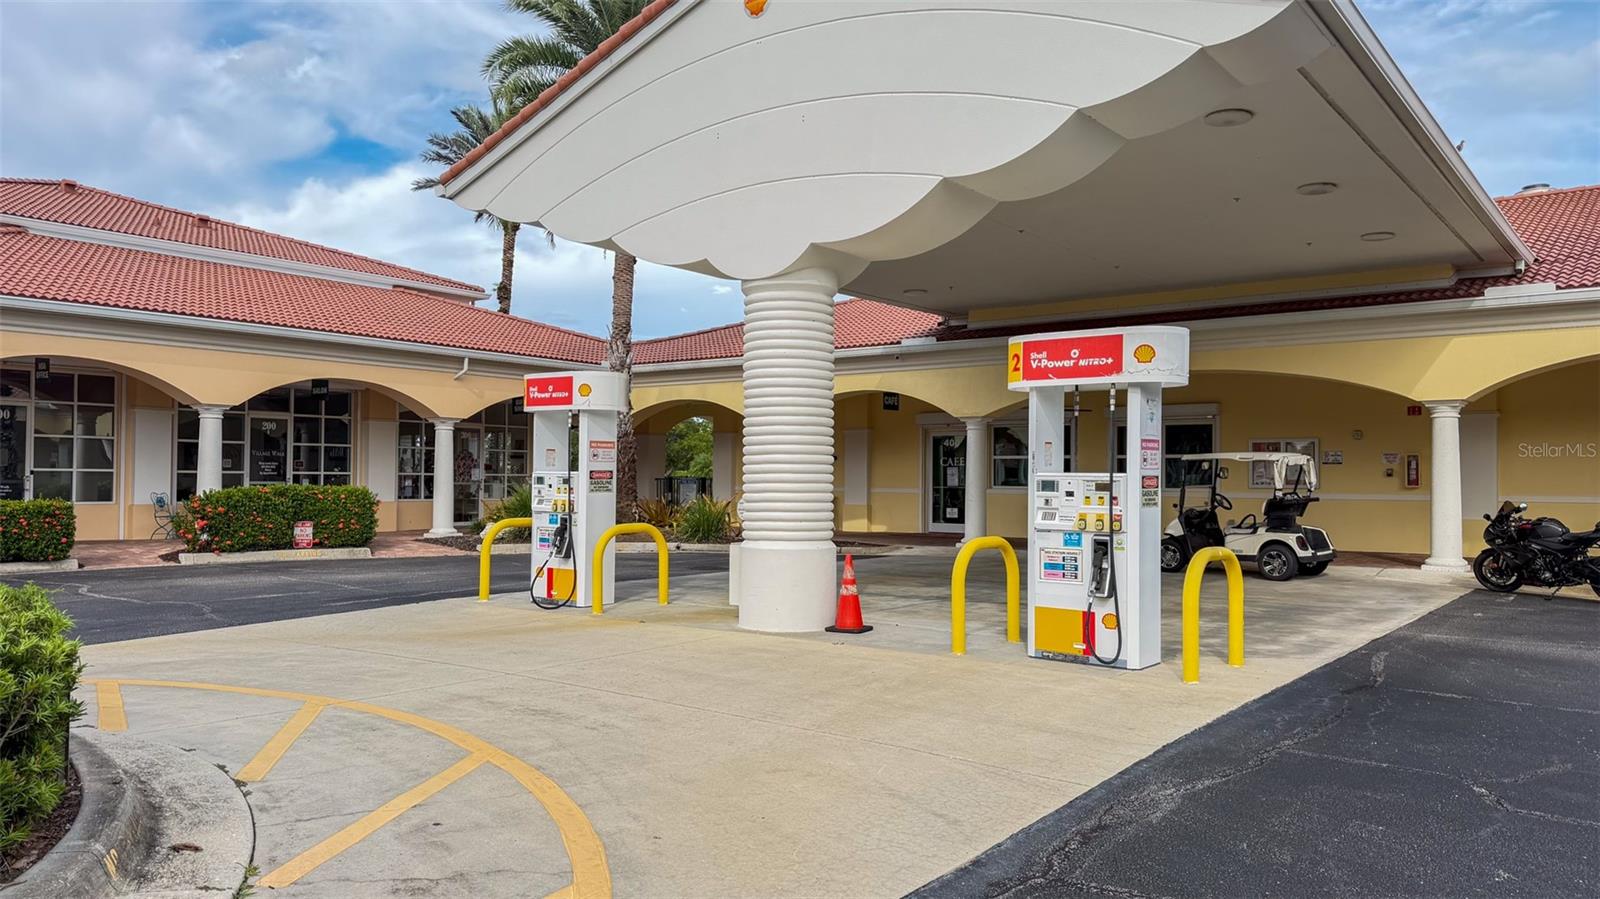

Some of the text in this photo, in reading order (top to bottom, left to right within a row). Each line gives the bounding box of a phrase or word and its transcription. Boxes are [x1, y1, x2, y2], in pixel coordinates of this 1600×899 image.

[1030, 351, 1047, 360] Shell
[1012, 353, 1020, 372] 2
[1030, 357, 1114, 369] V-Power NITRO+
[529, 391, 552, 399] V-Power
[262, 421, 276, 431] 200
